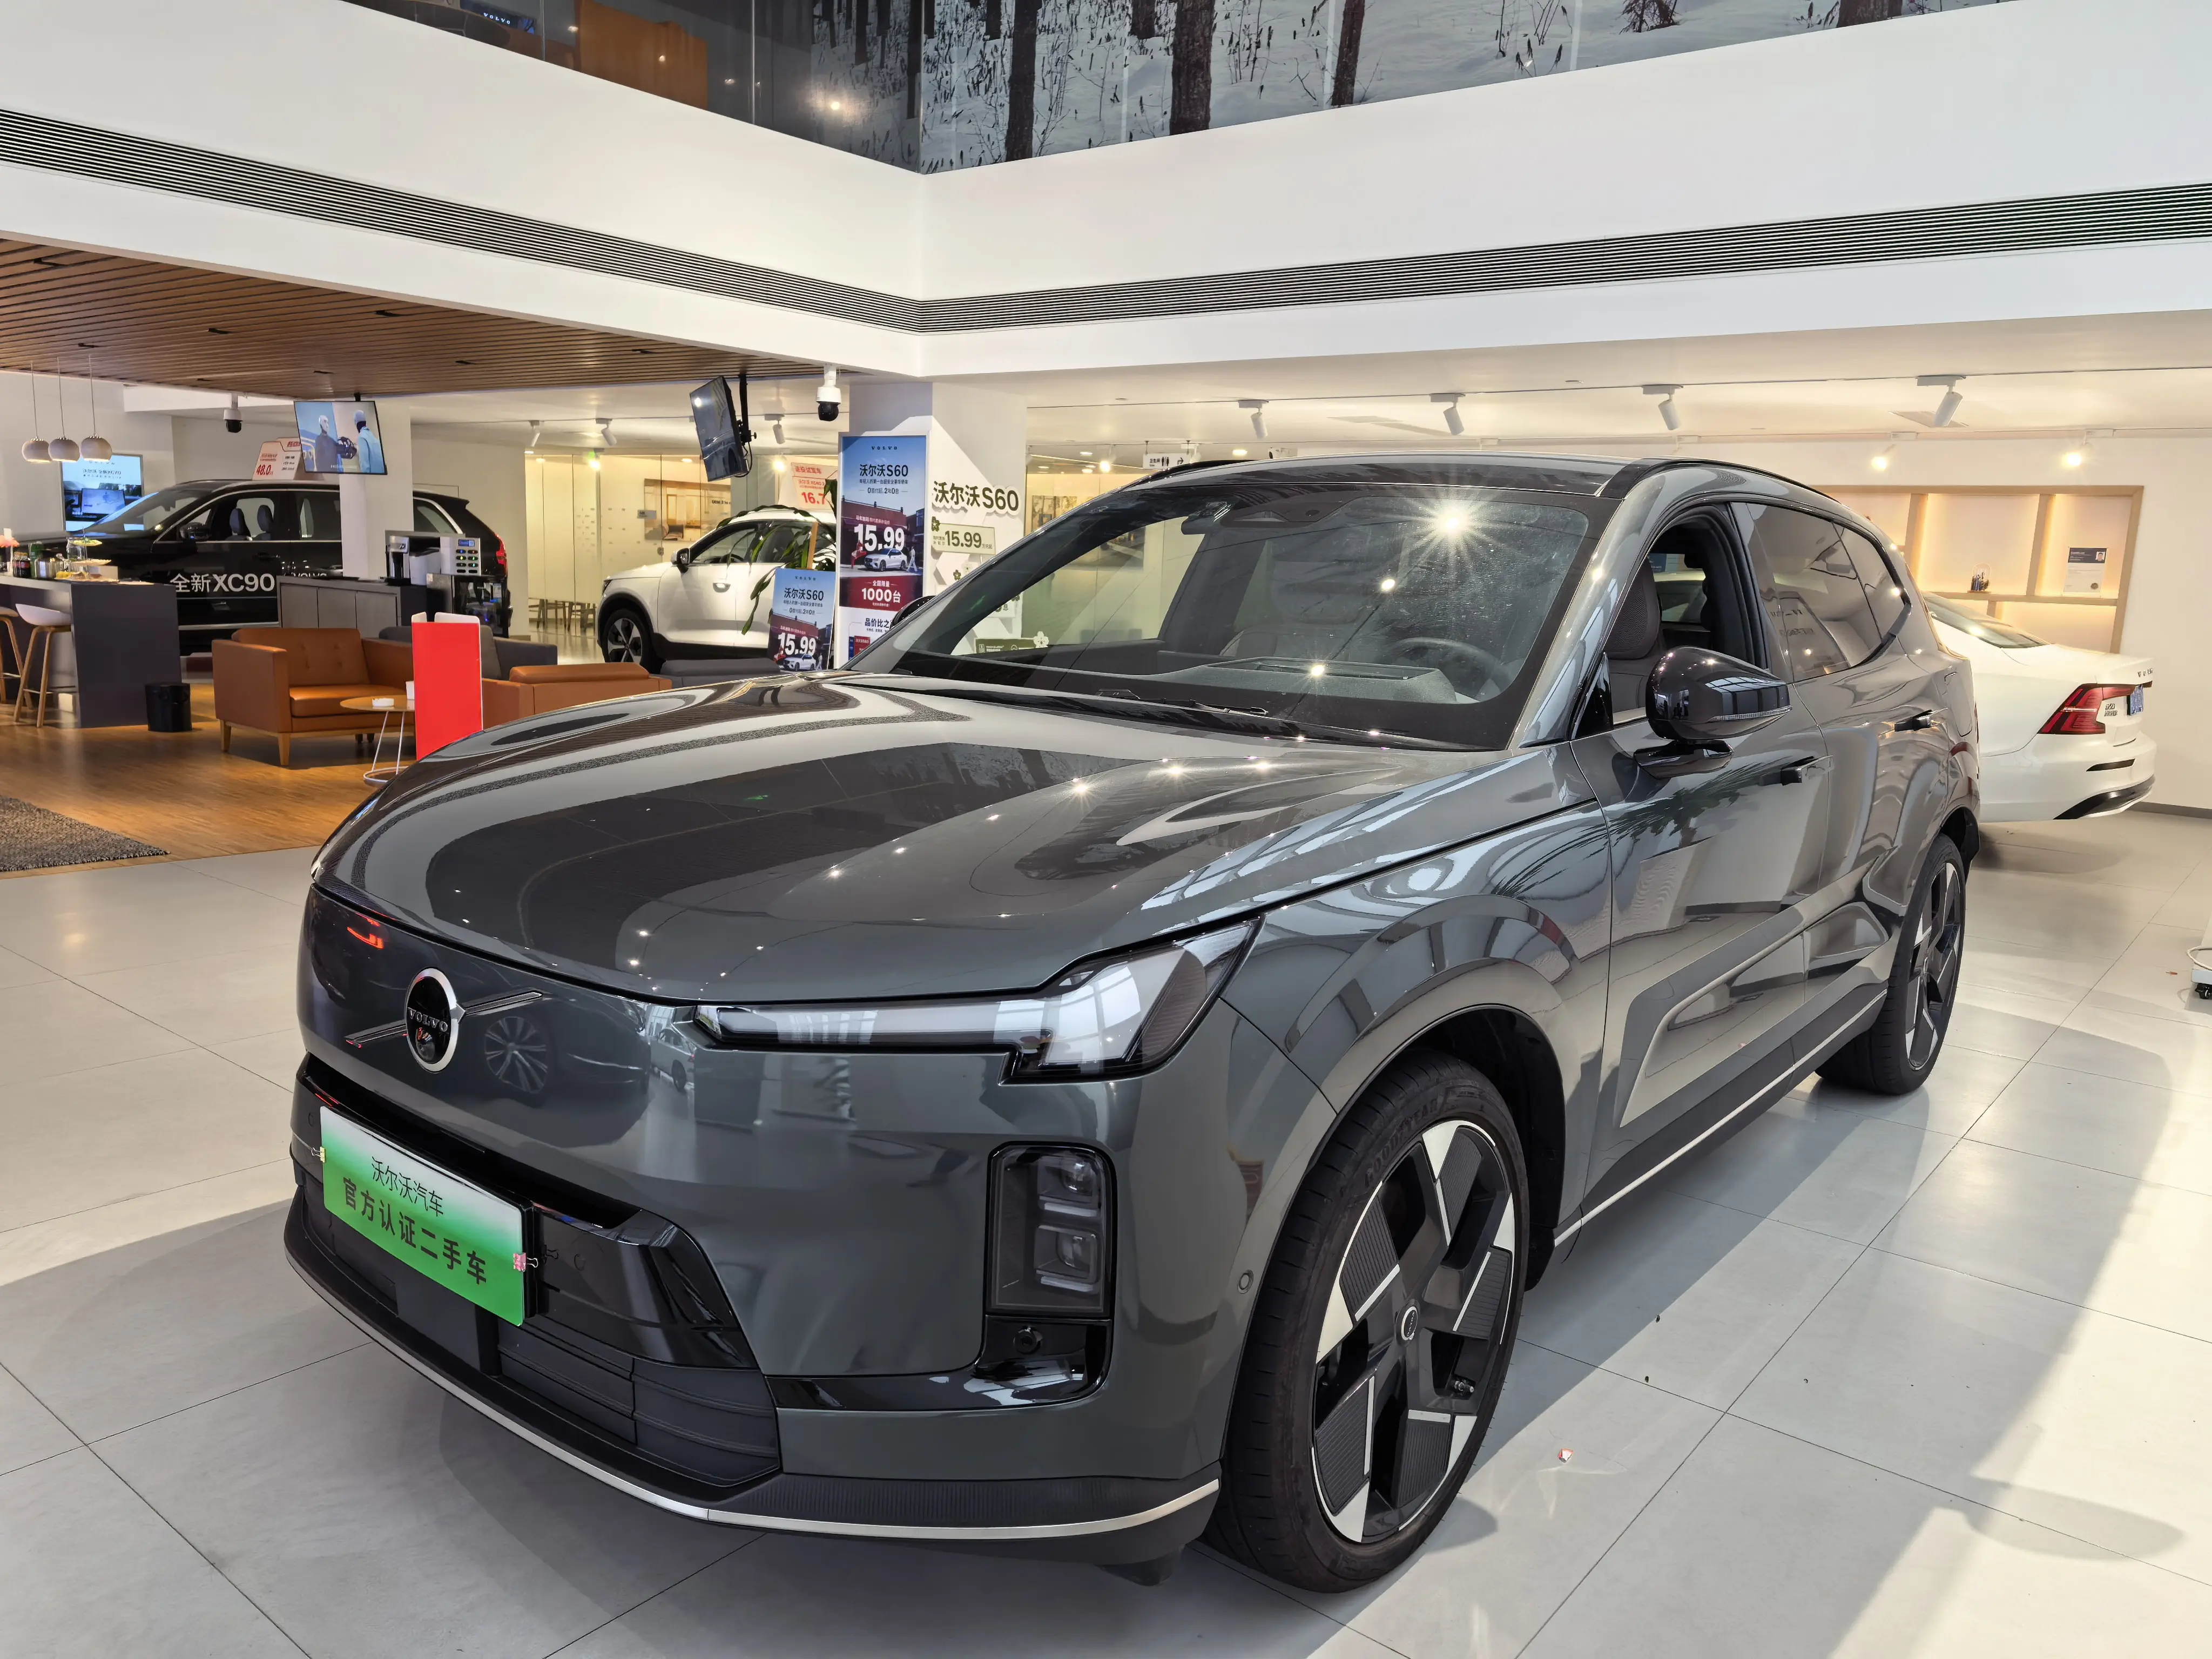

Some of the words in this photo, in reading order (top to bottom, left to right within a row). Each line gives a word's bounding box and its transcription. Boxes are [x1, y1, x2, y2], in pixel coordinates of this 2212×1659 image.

[483, 12, 510, 24] VOLVO
[860, 464, 908, 477] 沃尔沃S60
[933, 481, 1019, 511] 沃尔沃S60
[854, 523, 905, 551] 15.99
[945, 530, 982, 549] 15.99
[784, 588, 824, 601] 沃尔沃S60
[861, 588, 901, 603] 1000台
[865, 618, 891, 629] 品价比之
[778, 632, 817, 656] 15.99
[408, 1007, 448, 1032] VOLVO
[372, 1156, 443, 1217] 沃尔沃汽车
[343, 1177, 487, 1285] 官方认证二手车
